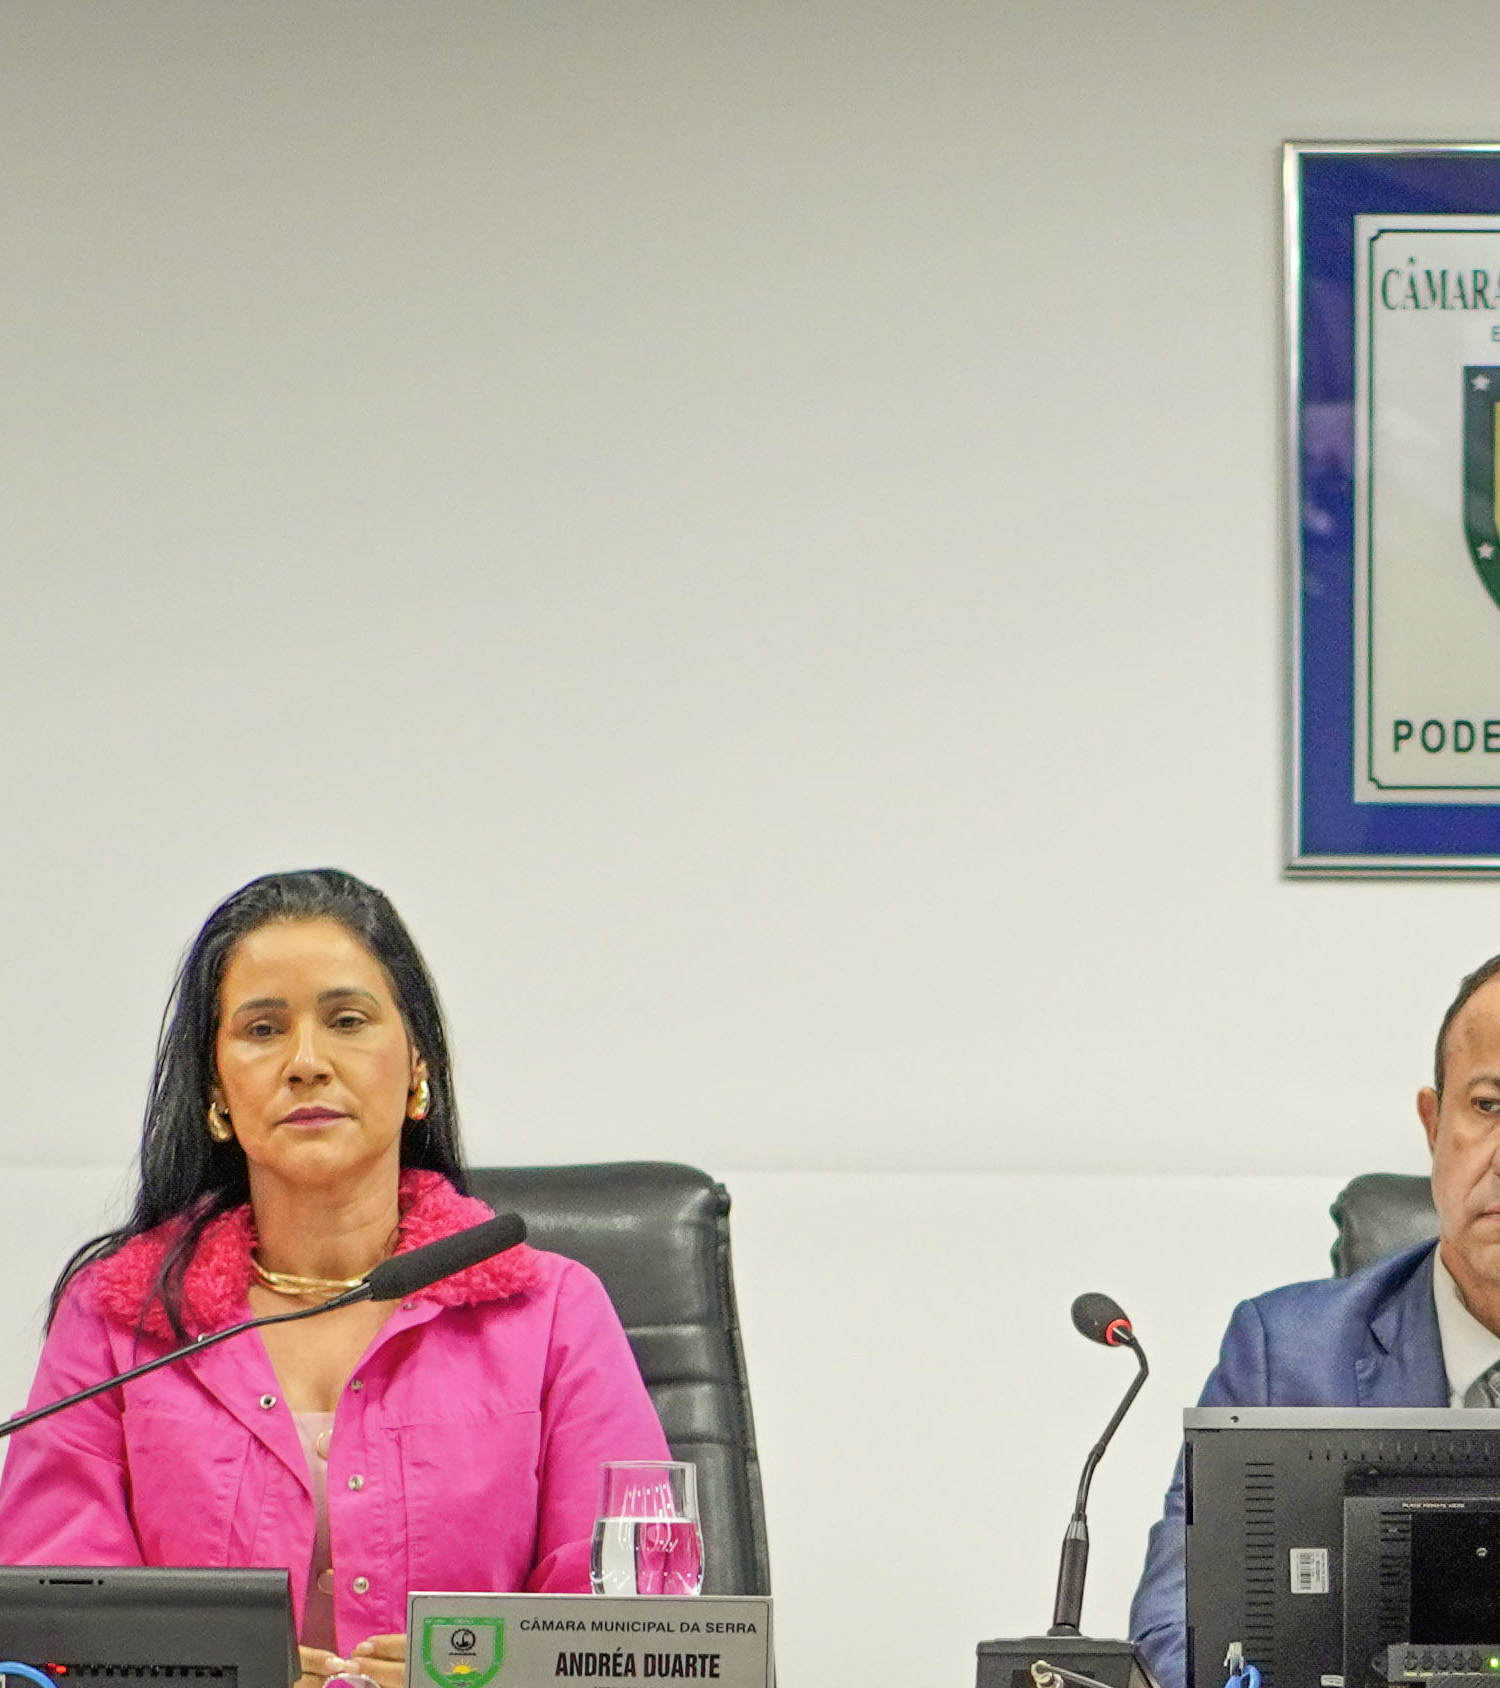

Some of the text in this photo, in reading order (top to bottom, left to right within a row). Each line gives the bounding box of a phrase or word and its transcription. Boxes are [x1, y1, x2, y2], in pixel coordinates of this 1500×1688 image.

[591, 1620, 675, 1633] MUNICIPAL
[680, 1621, 700, 1634] DA
[705, 1621, 757, 1634] SERRA
[555, 1647, 720, 1679] ANDRÉA DUARTE
